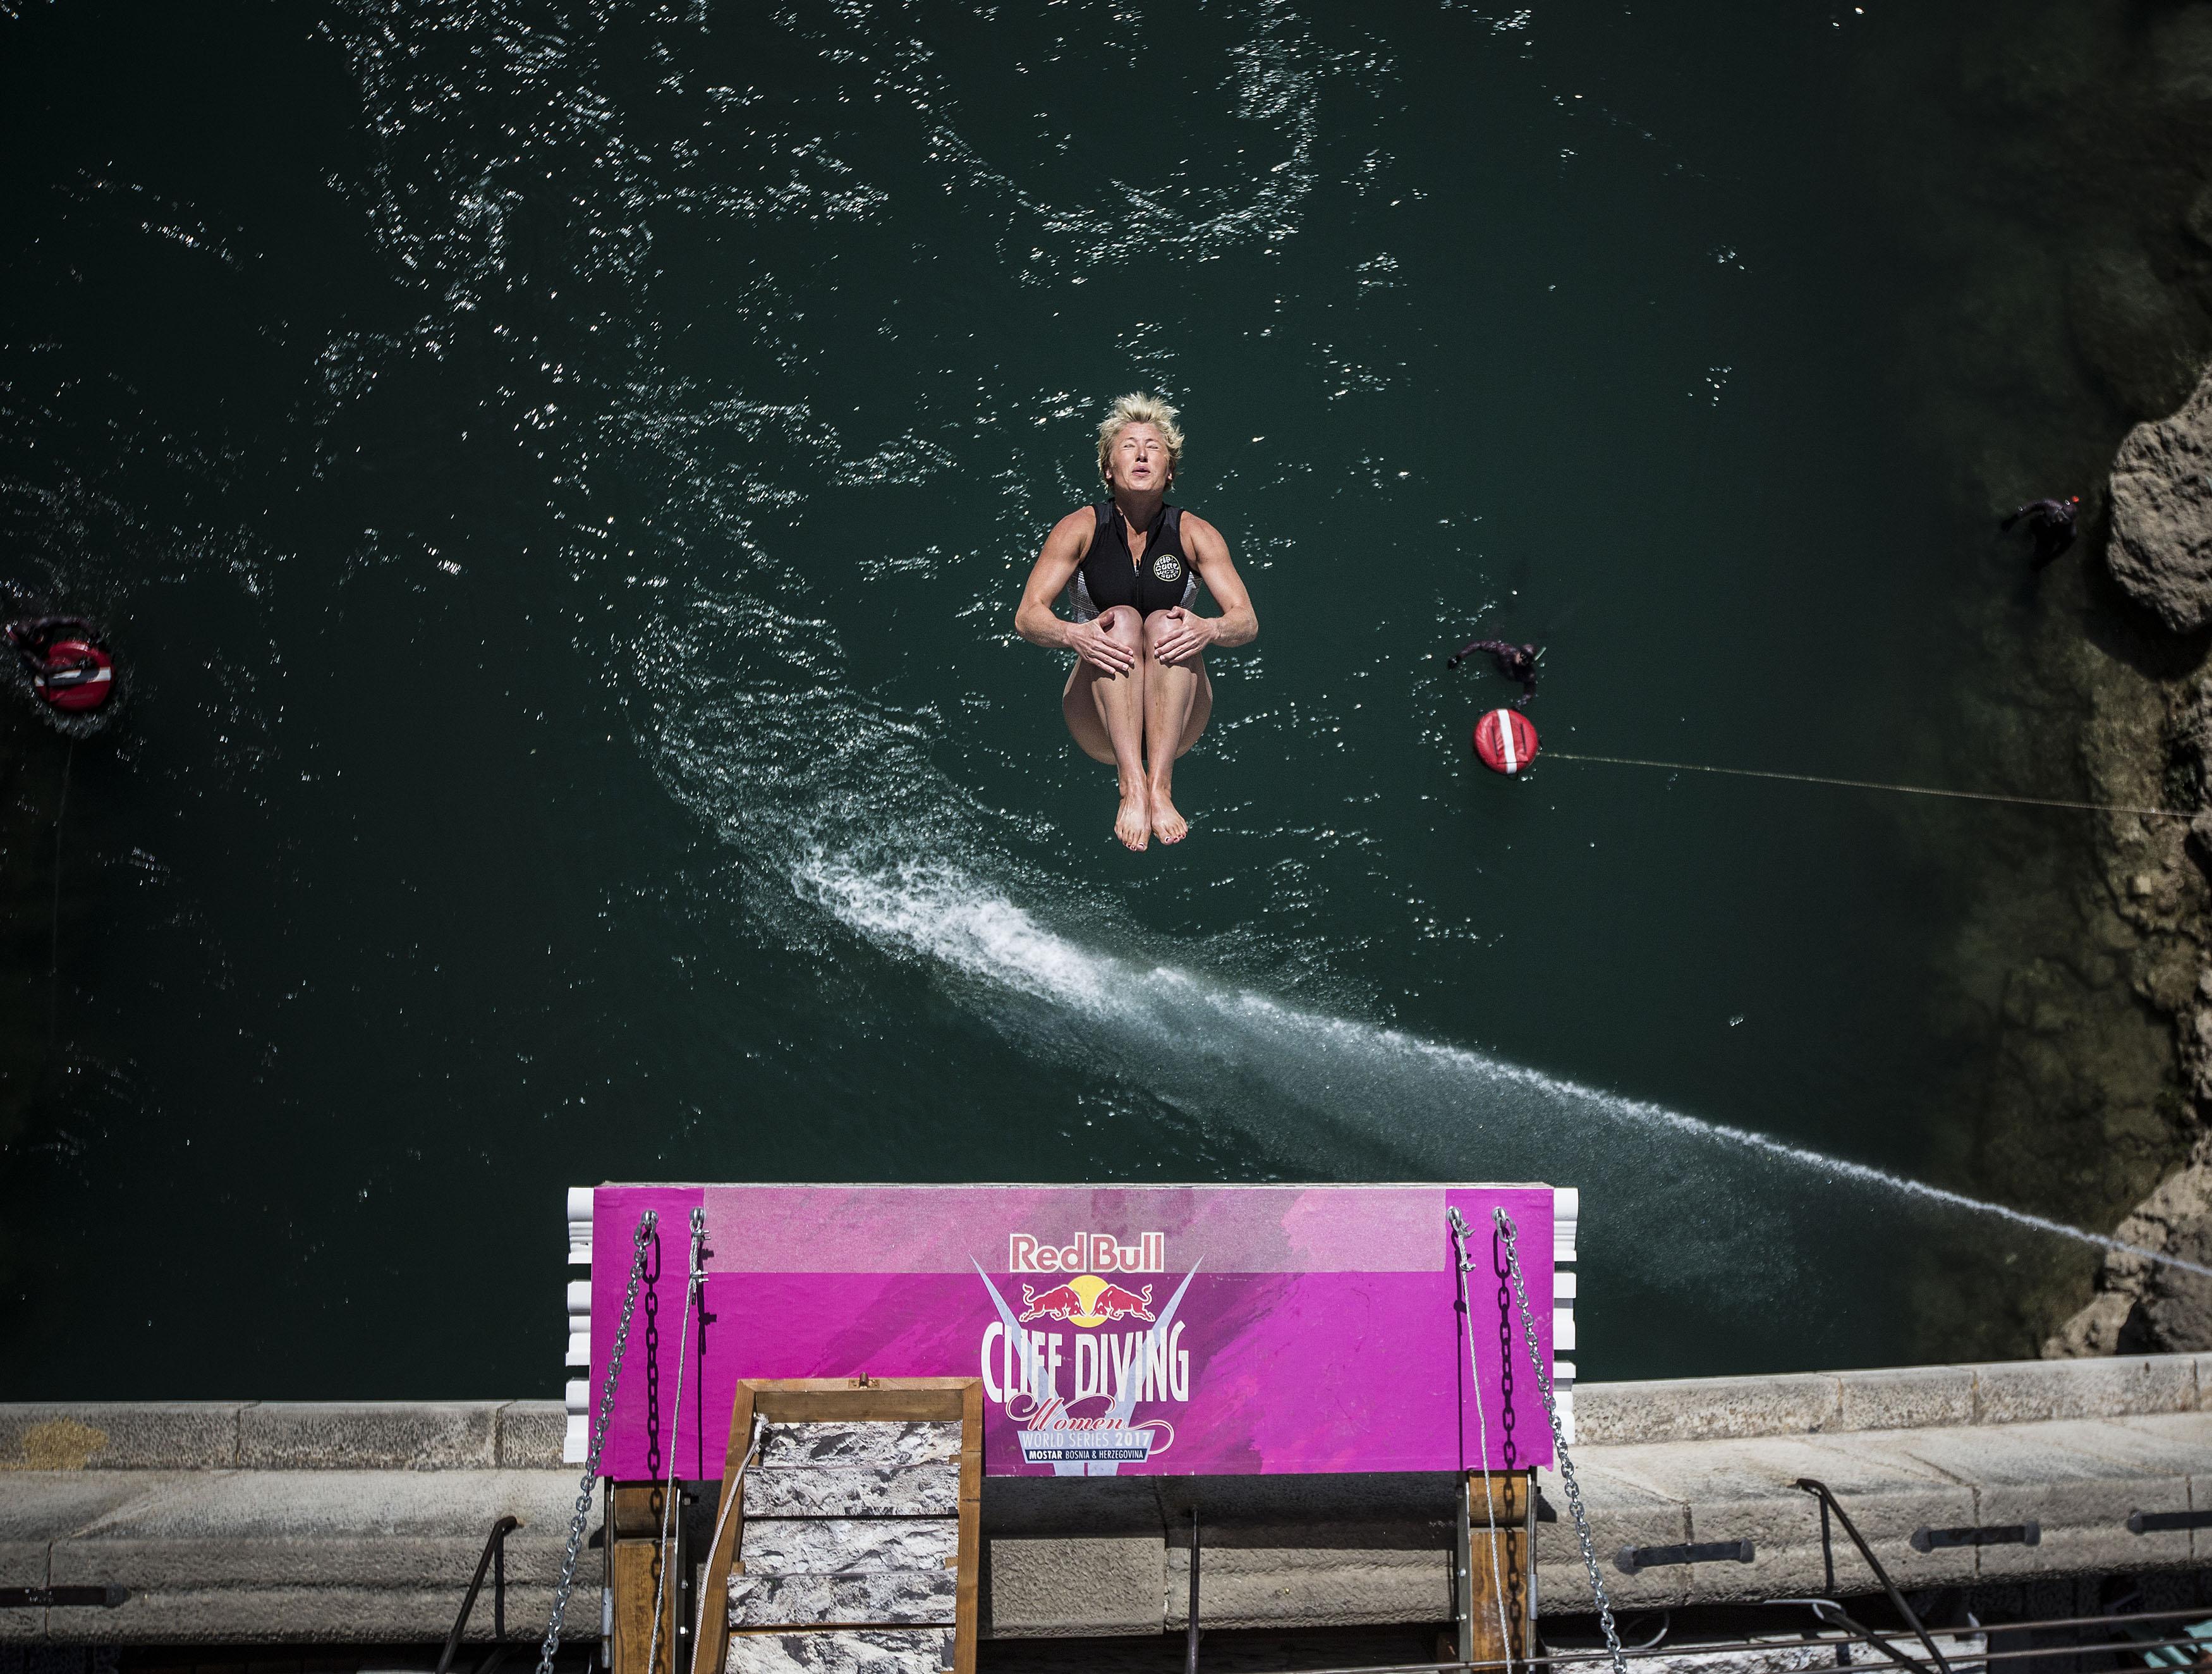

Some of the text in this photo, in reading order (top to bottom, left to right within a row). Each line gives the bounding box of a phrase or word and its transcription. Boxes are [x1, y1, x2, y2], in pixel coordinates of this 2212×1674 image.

[1155, 563, 1179, 572] CURL
[1156, 556, 1171, 566] RIP
[1010, 1232, 1164, 1273] Red Bull
[981, 1320, 1189, 1403] CLIFF DIVING
[1022, 1432, 1152, 1448] WORLD SERIES 2017
[1029, 1450, 1143, 1460] MOSTAR BOSNIA & HERZEGOVINA
